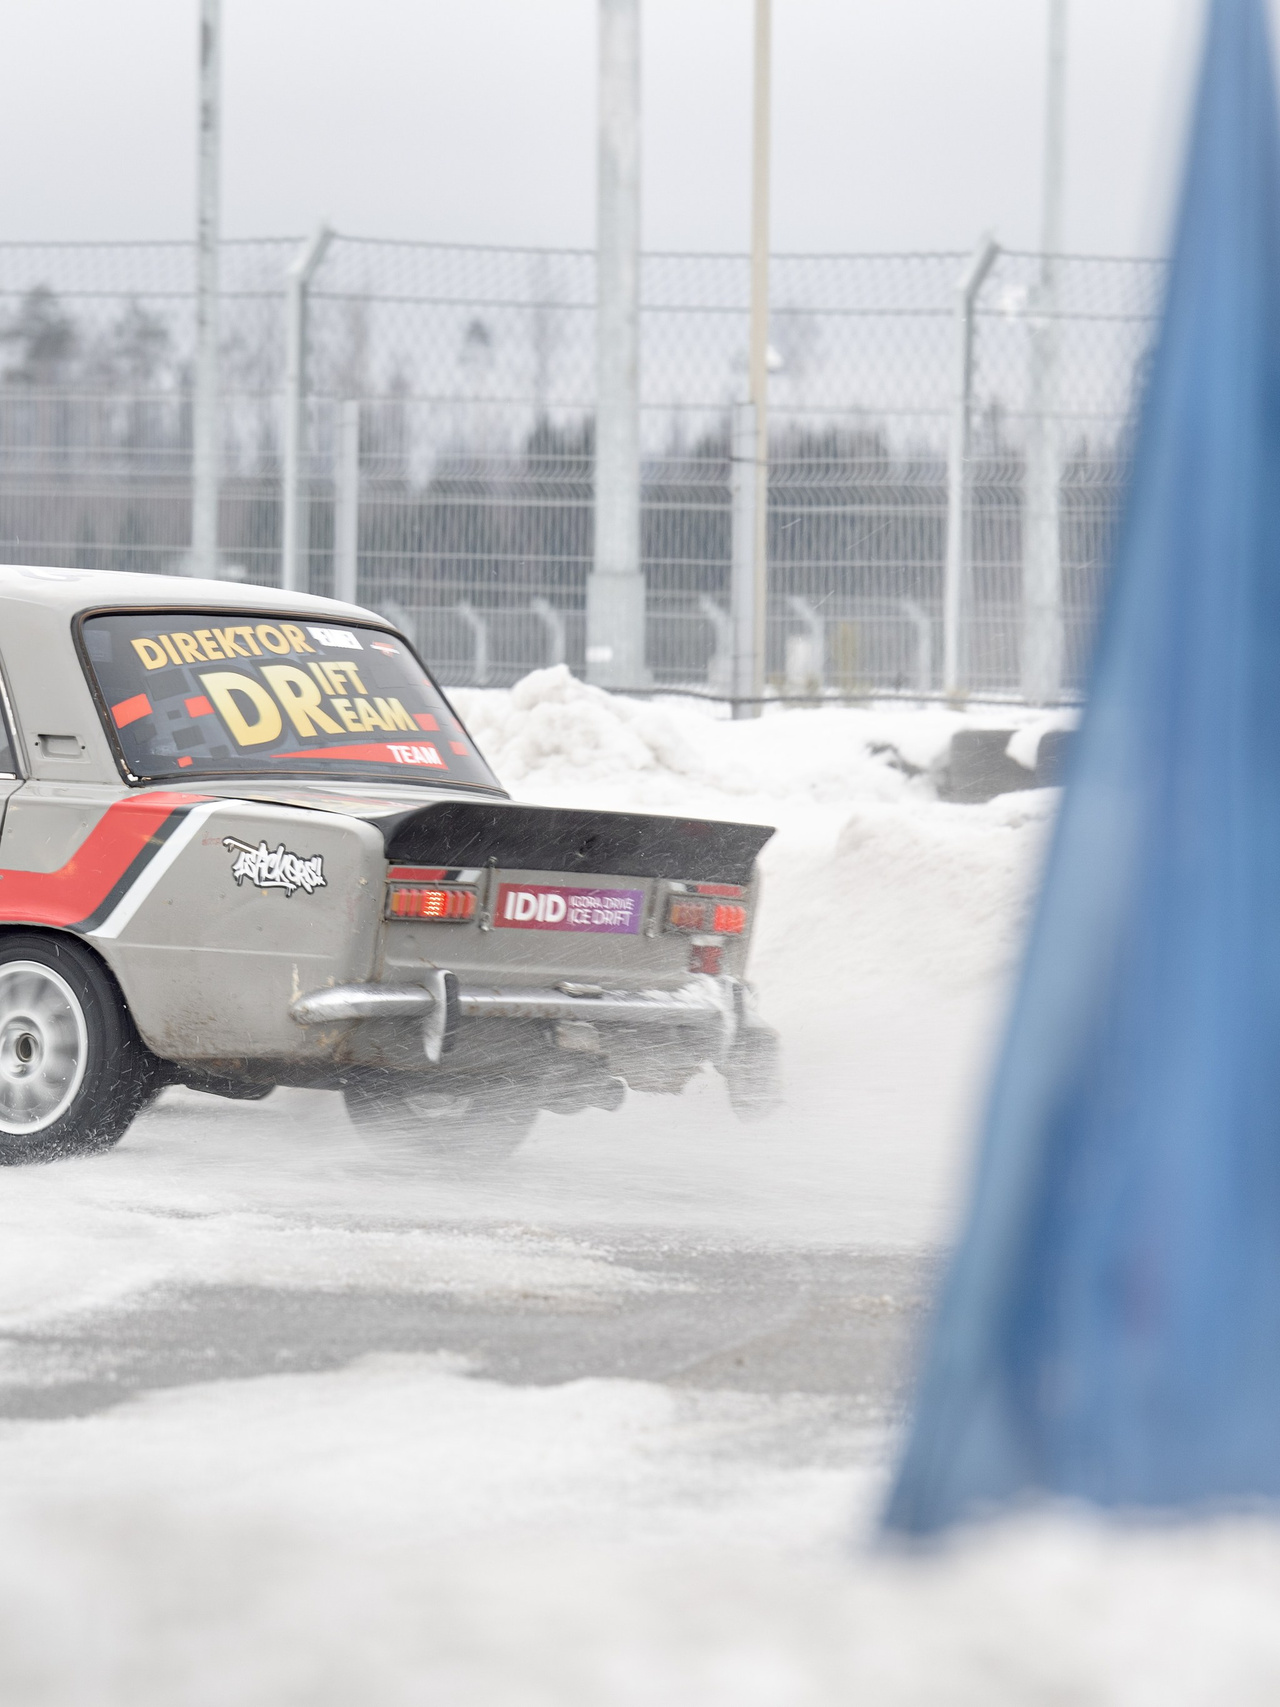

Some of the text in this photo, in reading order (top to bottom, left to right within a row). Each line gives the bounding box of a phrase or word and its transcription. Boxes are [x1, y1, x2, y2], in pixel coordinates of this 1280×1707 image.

[130, 624, 315, 671] DIREKTOR
[387, 744, 441, 765] TEAM
[504, 891, 567, 923] IDID
[567, 908, 634, 926] ICE DRIFT
